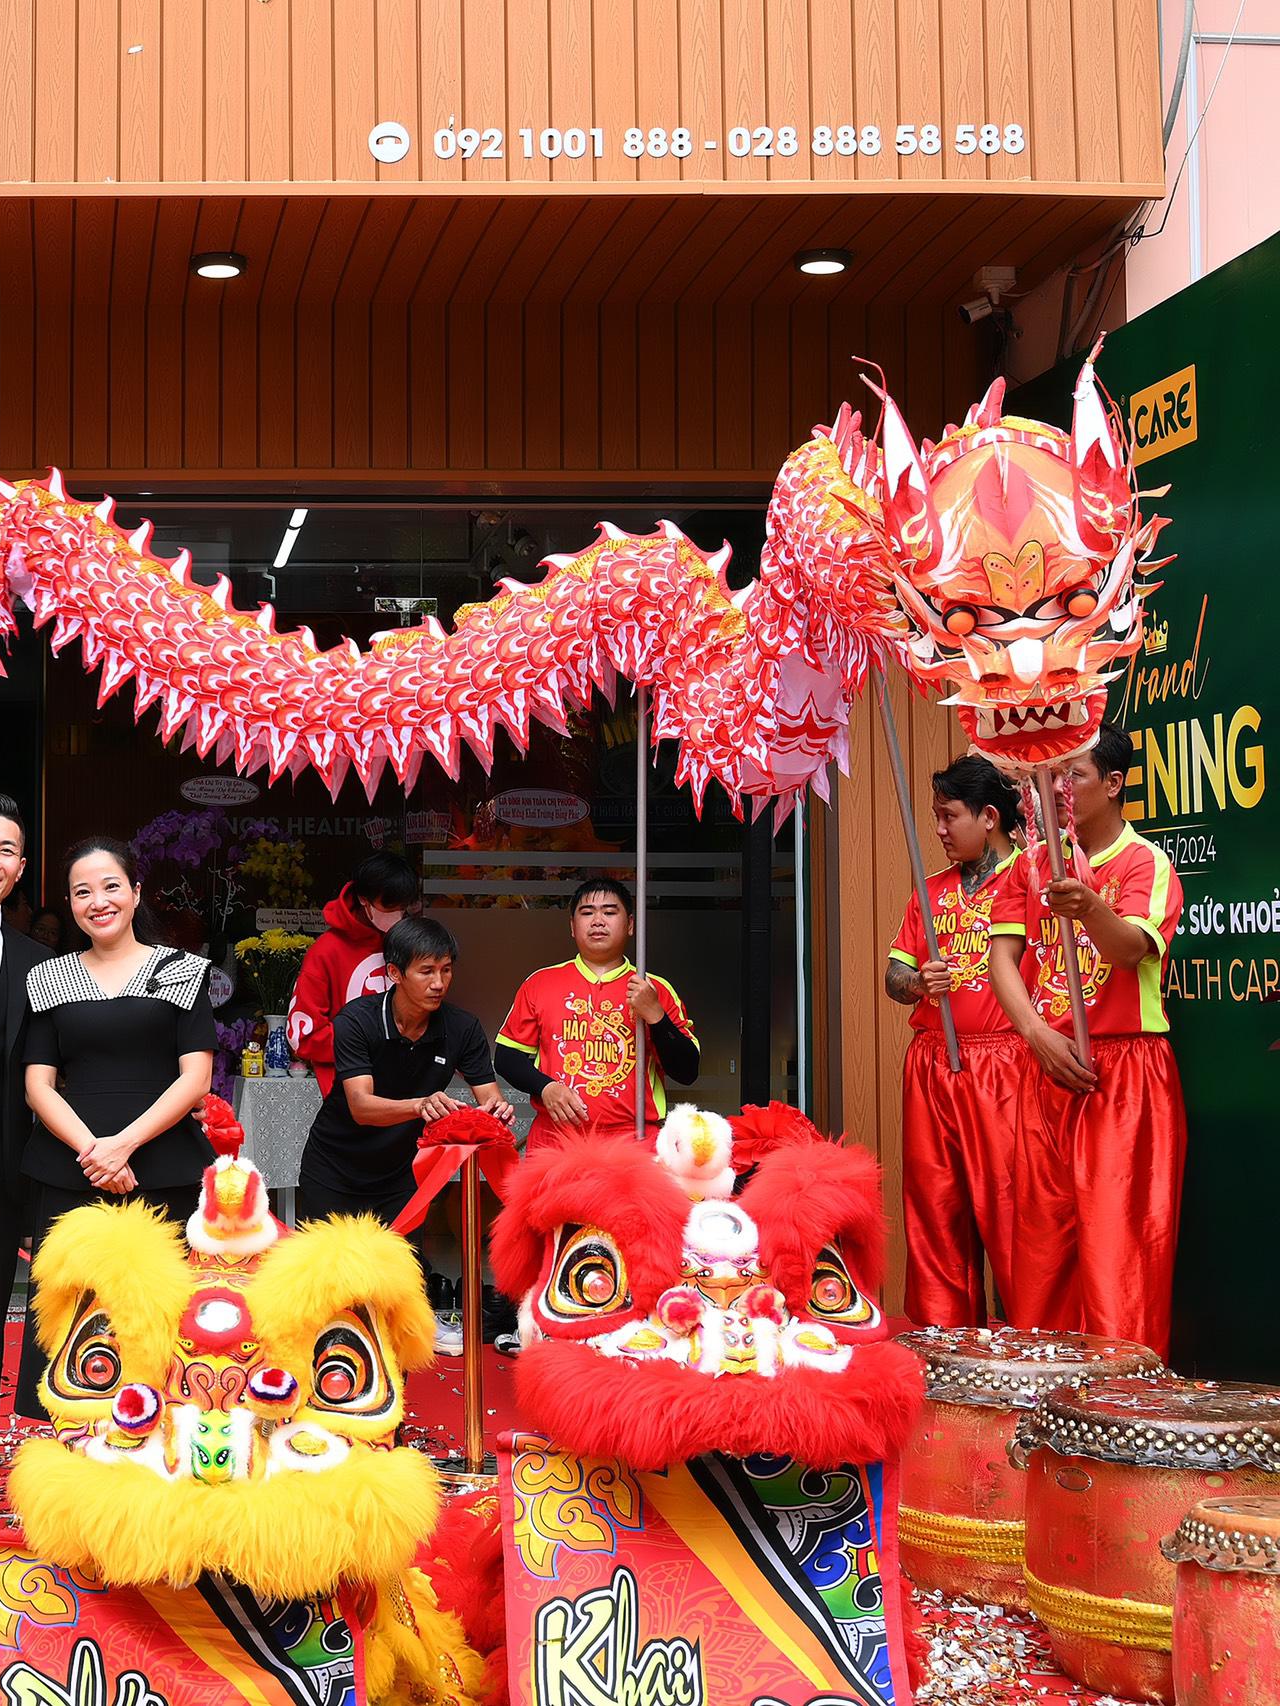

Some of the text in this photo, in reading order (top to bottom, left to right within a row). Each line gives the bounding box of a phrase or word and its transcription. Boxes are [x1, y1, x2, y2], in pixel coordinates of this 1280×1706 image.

[433, 128, 503, 160] 092
[518, 127, 604, 160] 1001
[622, 127, 693, 160] 888
[728, 126, 799, 158] 028
[811, 125, 882, 156] 888
[895, 125, 942, 155] 58
[955, 124, 1025, 155] 588
[1134, 381, 1192, 448] CARE
[1121, 704, 1266, 822] ENING
[1188, 895, 1226, 935] SỨC
[950, 927, 988, 954] DŨNG
[1161, 958, 1222, 1000] ALTH
[563, 1014, 588, 1040] HÀO
[586, 1036, 619, 1064] DŨNG
[538, 1567, 702, 1706] Khai
